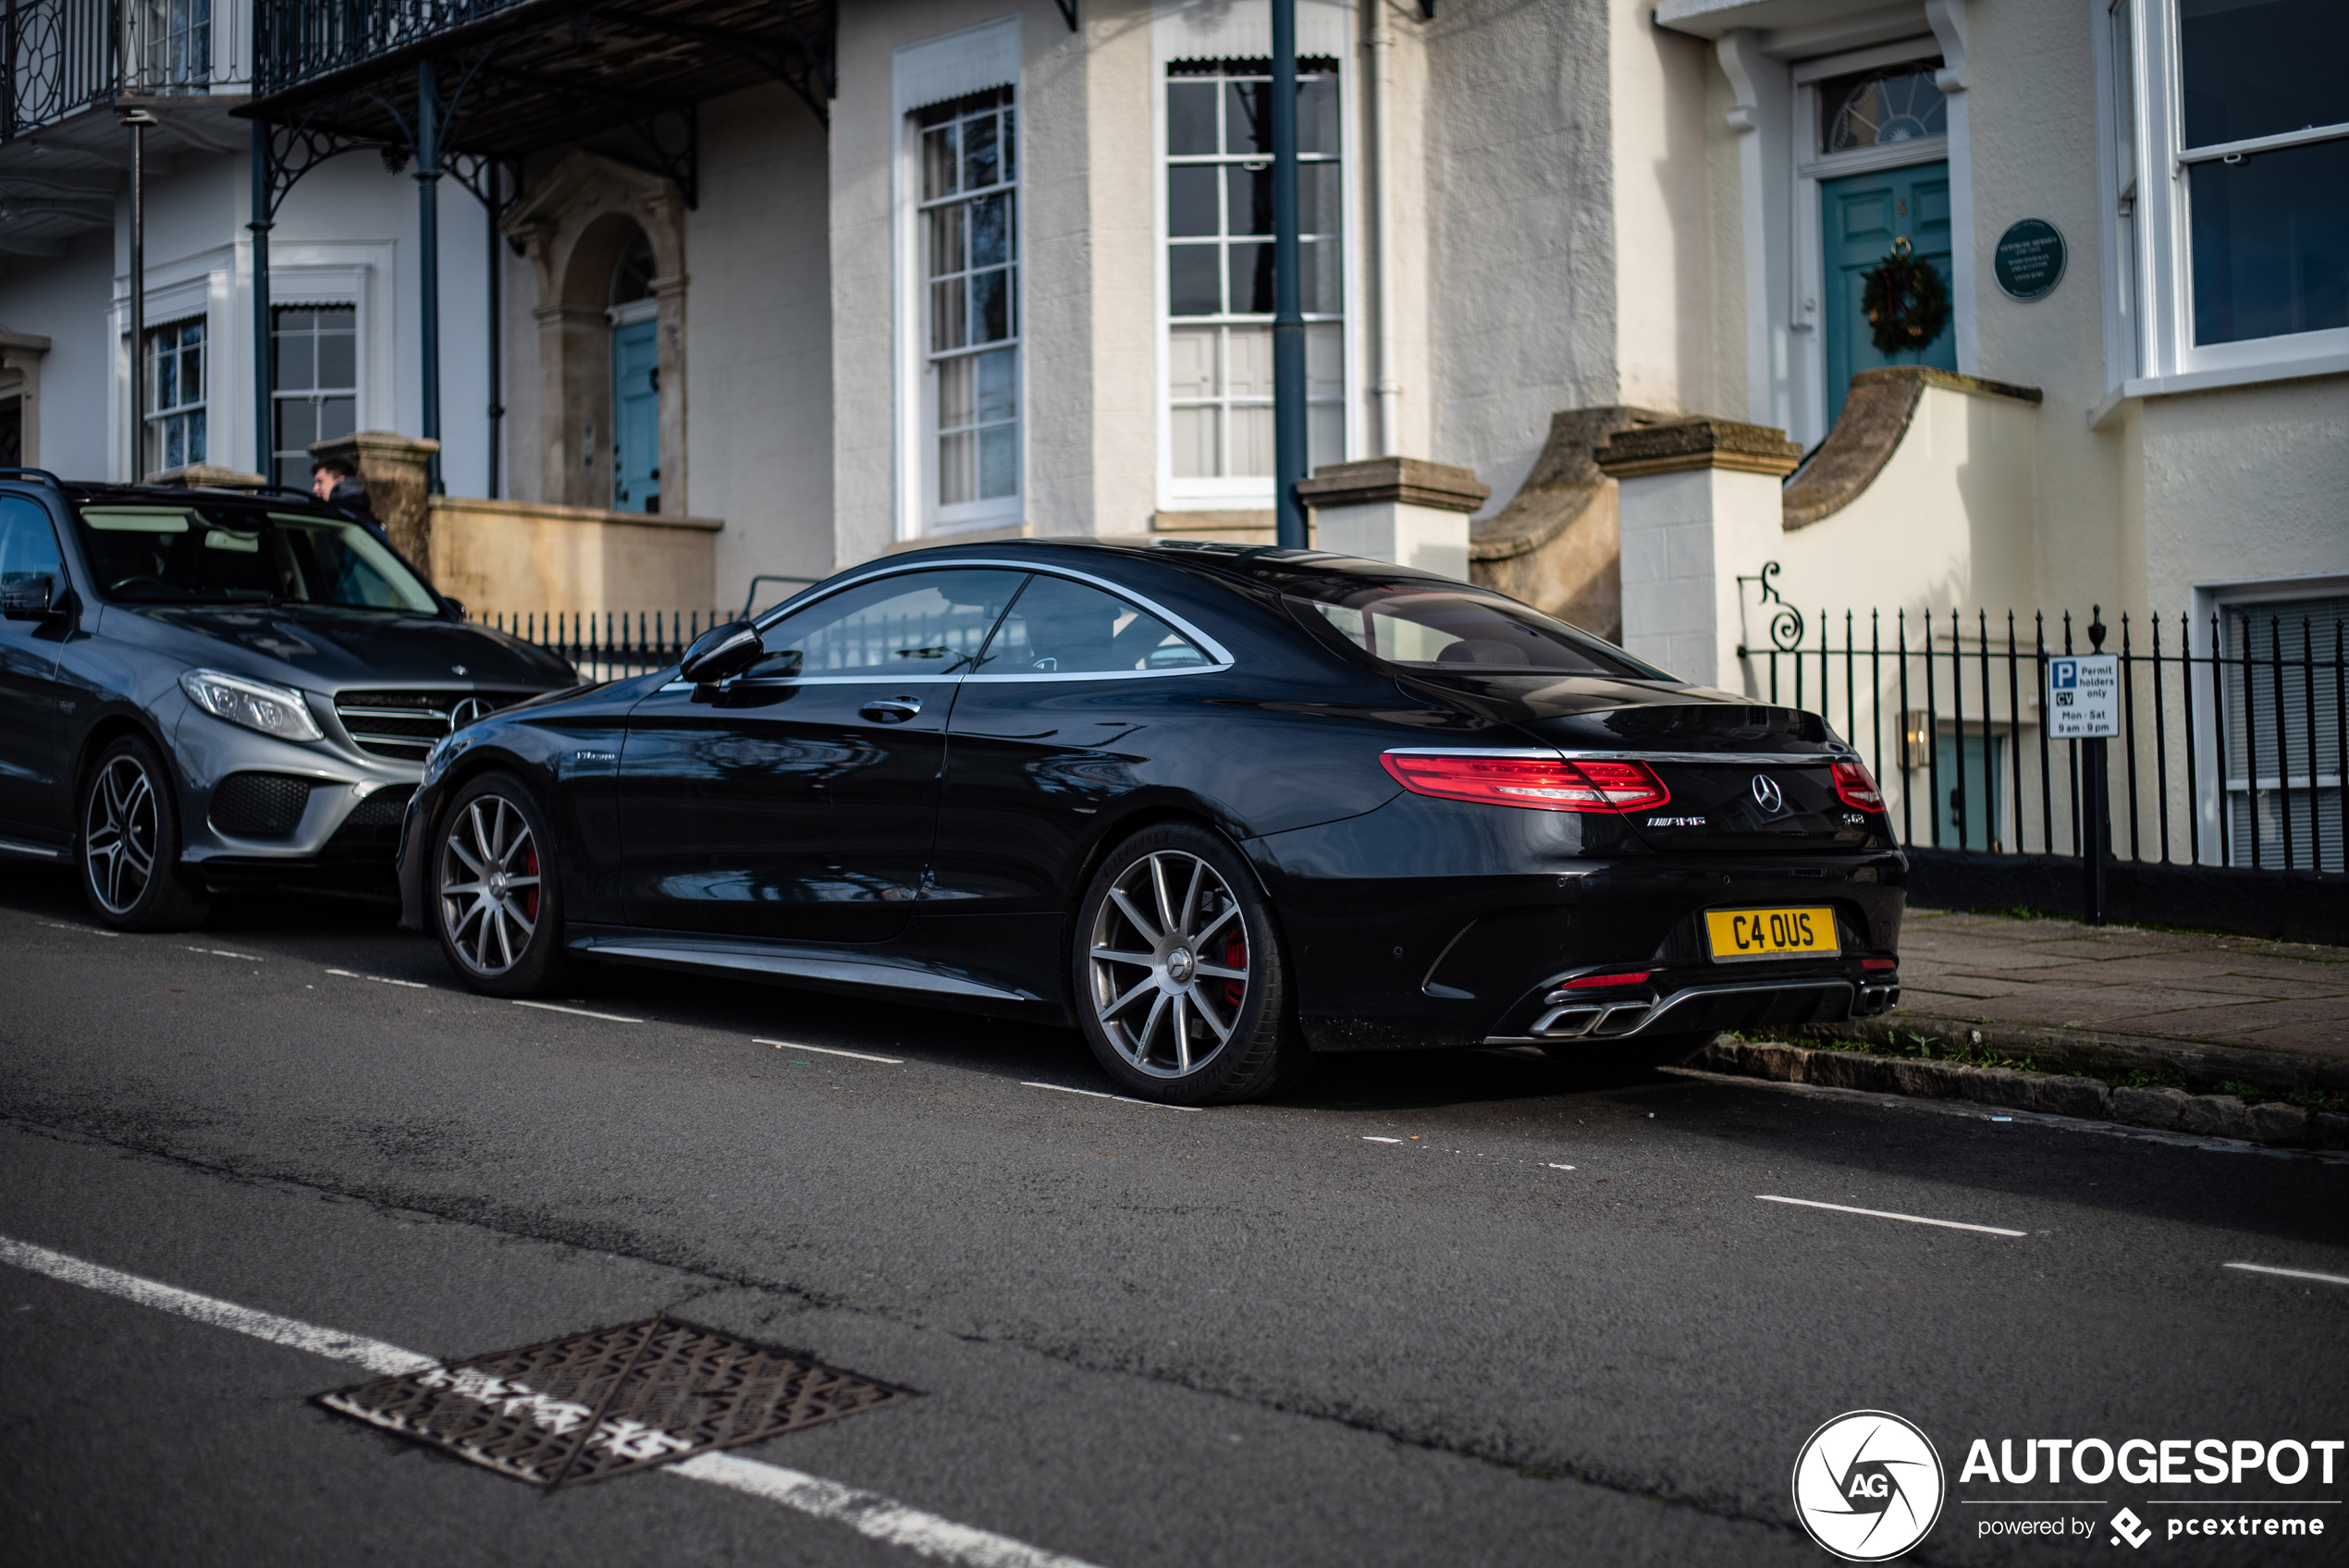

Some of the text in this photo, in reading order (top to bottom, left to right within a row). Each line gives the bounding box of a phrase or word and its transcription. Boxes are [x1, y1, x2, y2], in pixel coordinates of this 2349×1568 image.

[1897, 198, 1908, 217] 5
[2058, 663, 2073, 687] P
[2082, 666, 2112, 676] Permit
[2080, 678, 2114, 687] holders
[2057, 692, 2072, 705] CV
[2087, 688, 2107, 699] only
[2061, 710, 2082, 721] Mon
[2089, 709, 2105, 720] Sat
[2058, 723, 2064, 733] 9
[2066, 724, 2080, 733] am
[2086, 722, 2093, 732] 9
[2095, 723, 2109, 734] pm
[1732, 913, 1814, 949] C4 OUS
